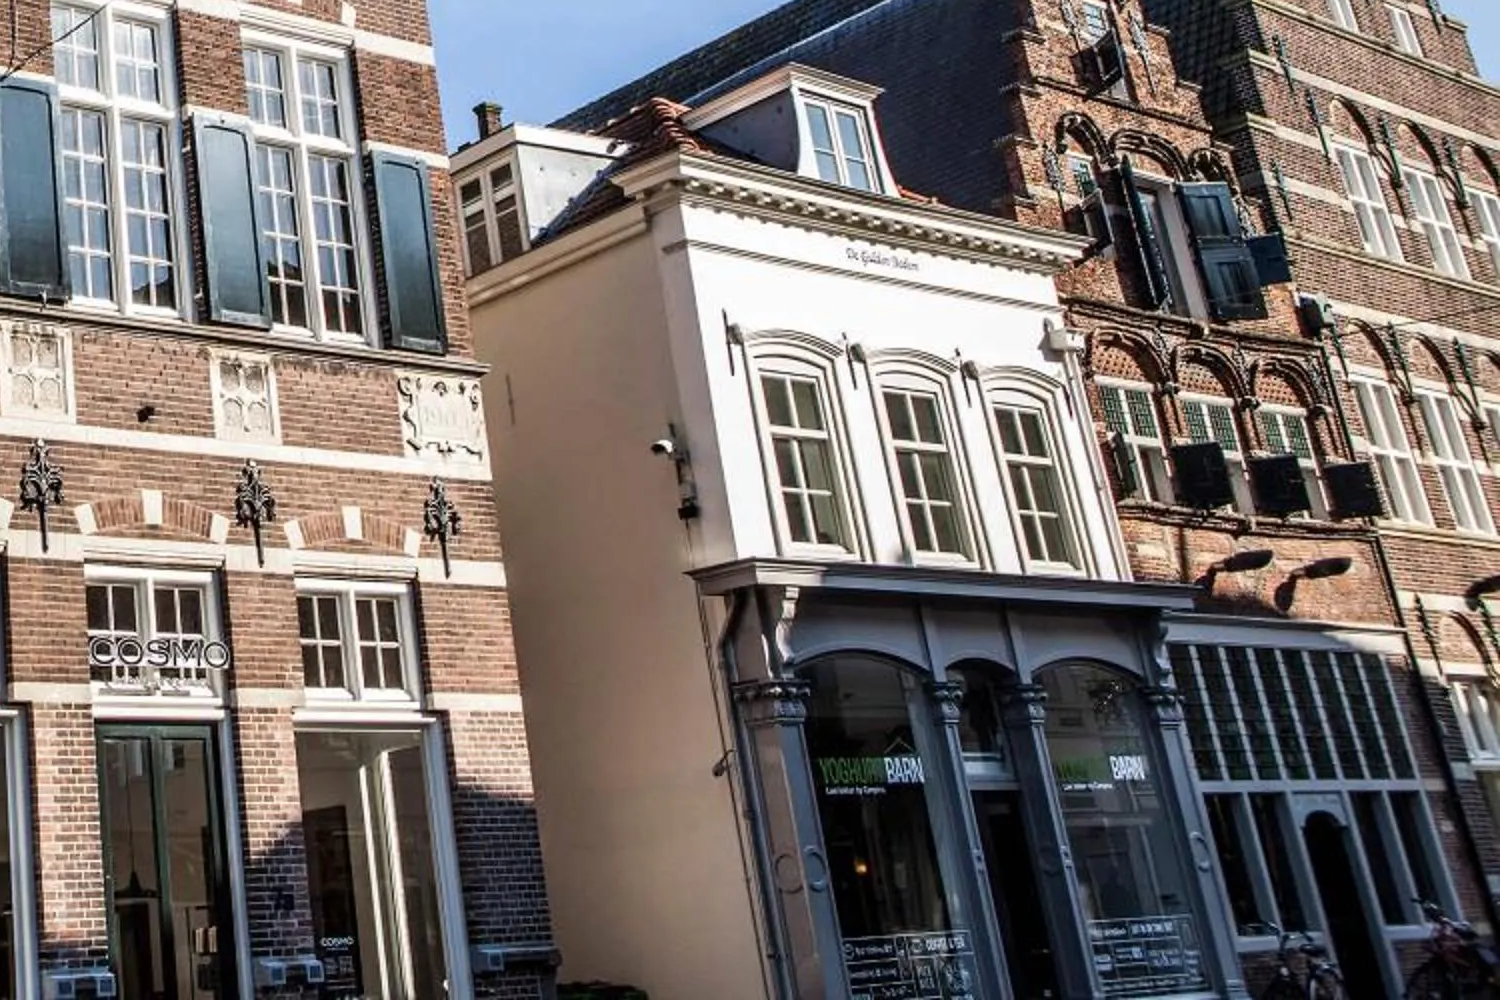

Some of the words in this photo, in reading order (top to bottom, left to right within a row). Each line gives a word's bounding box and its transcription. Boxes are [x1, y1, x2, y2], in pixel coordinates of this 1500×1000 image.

[90, 636, 231, 669] COSMO
[884, 756, 925, 784] BARN
[1109, 755, 1146, 780] BARN
